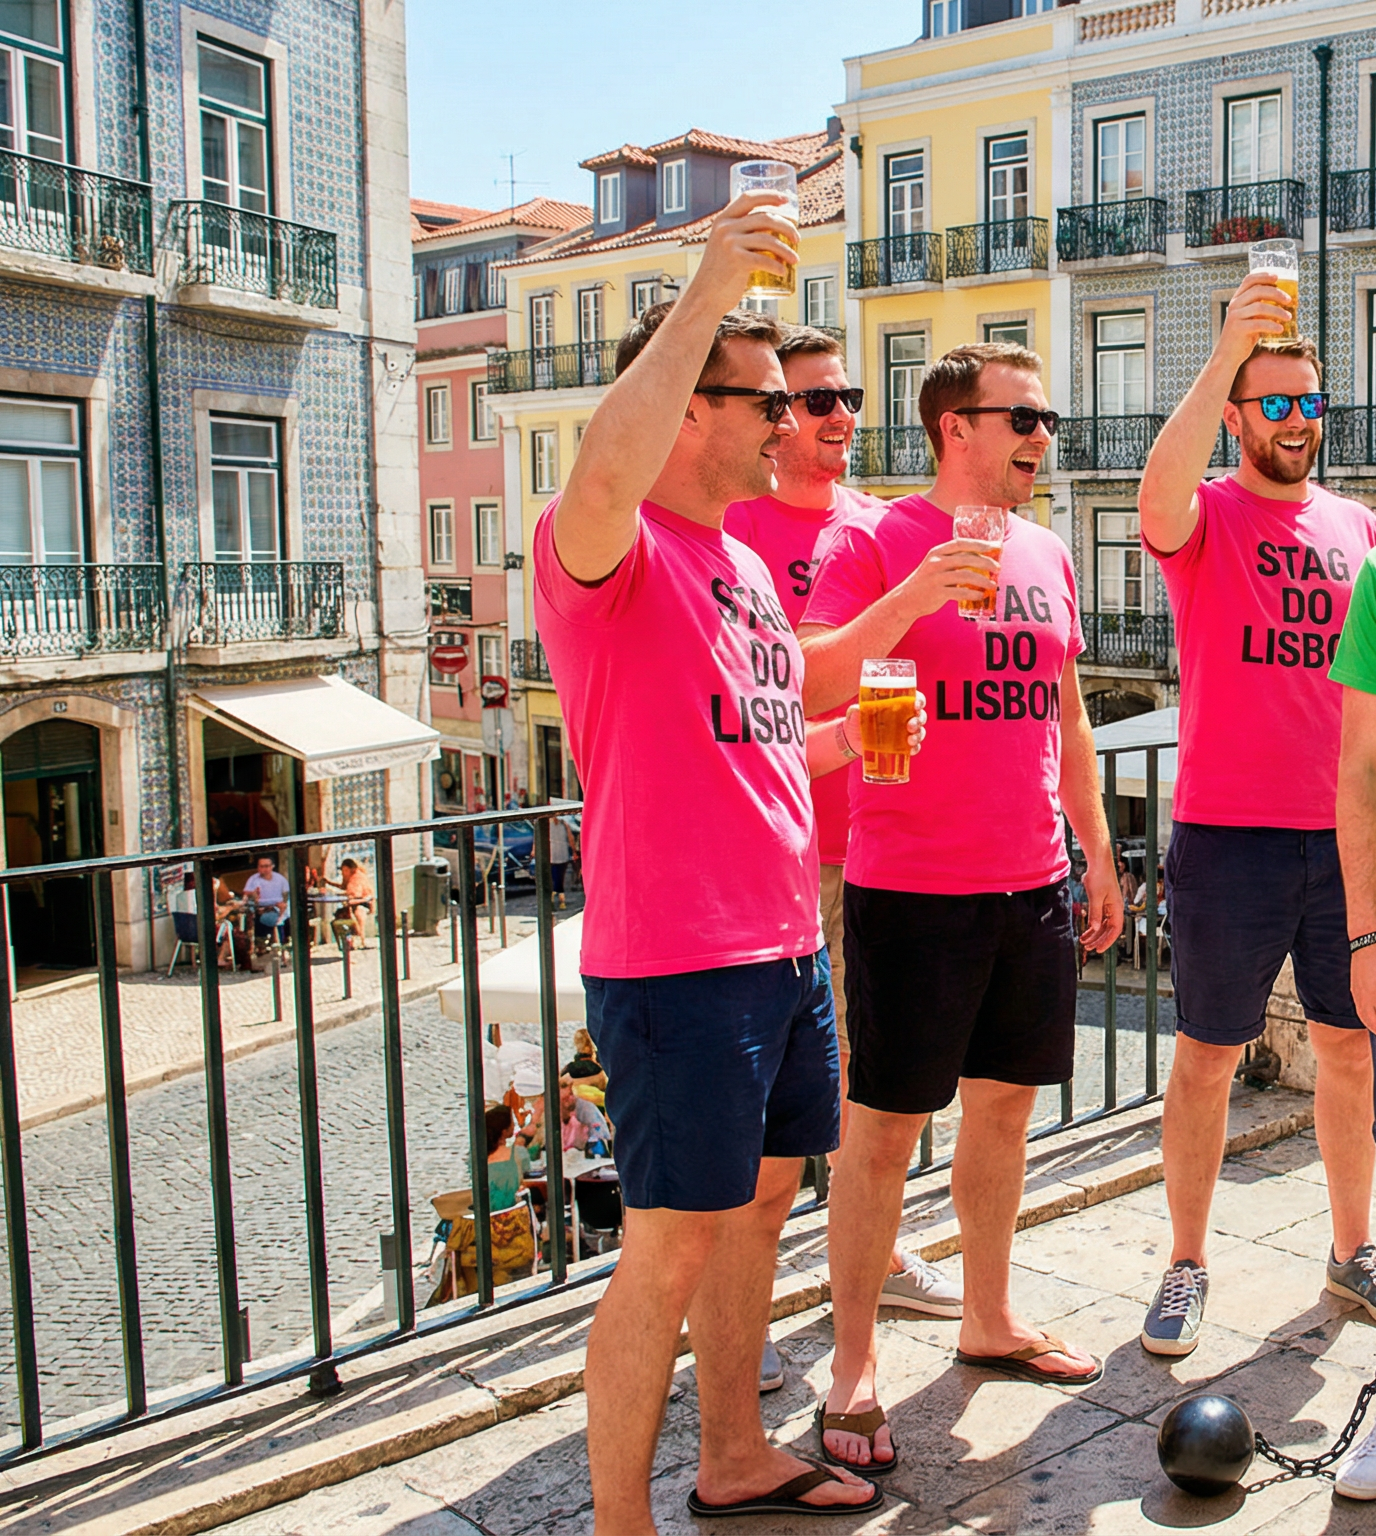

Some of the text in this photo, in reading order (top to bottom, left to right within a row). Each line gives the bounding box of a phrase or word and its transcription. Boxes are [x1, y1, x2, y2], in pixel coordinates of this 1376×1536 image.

[1257, 541, 1350, 582] STAG
[1282, 587, 1332, 625] DO
[750, 639, 790, 690] DO
[985, 631, 1037, 672] DO
[711, 694, 806, 747] LISBO
